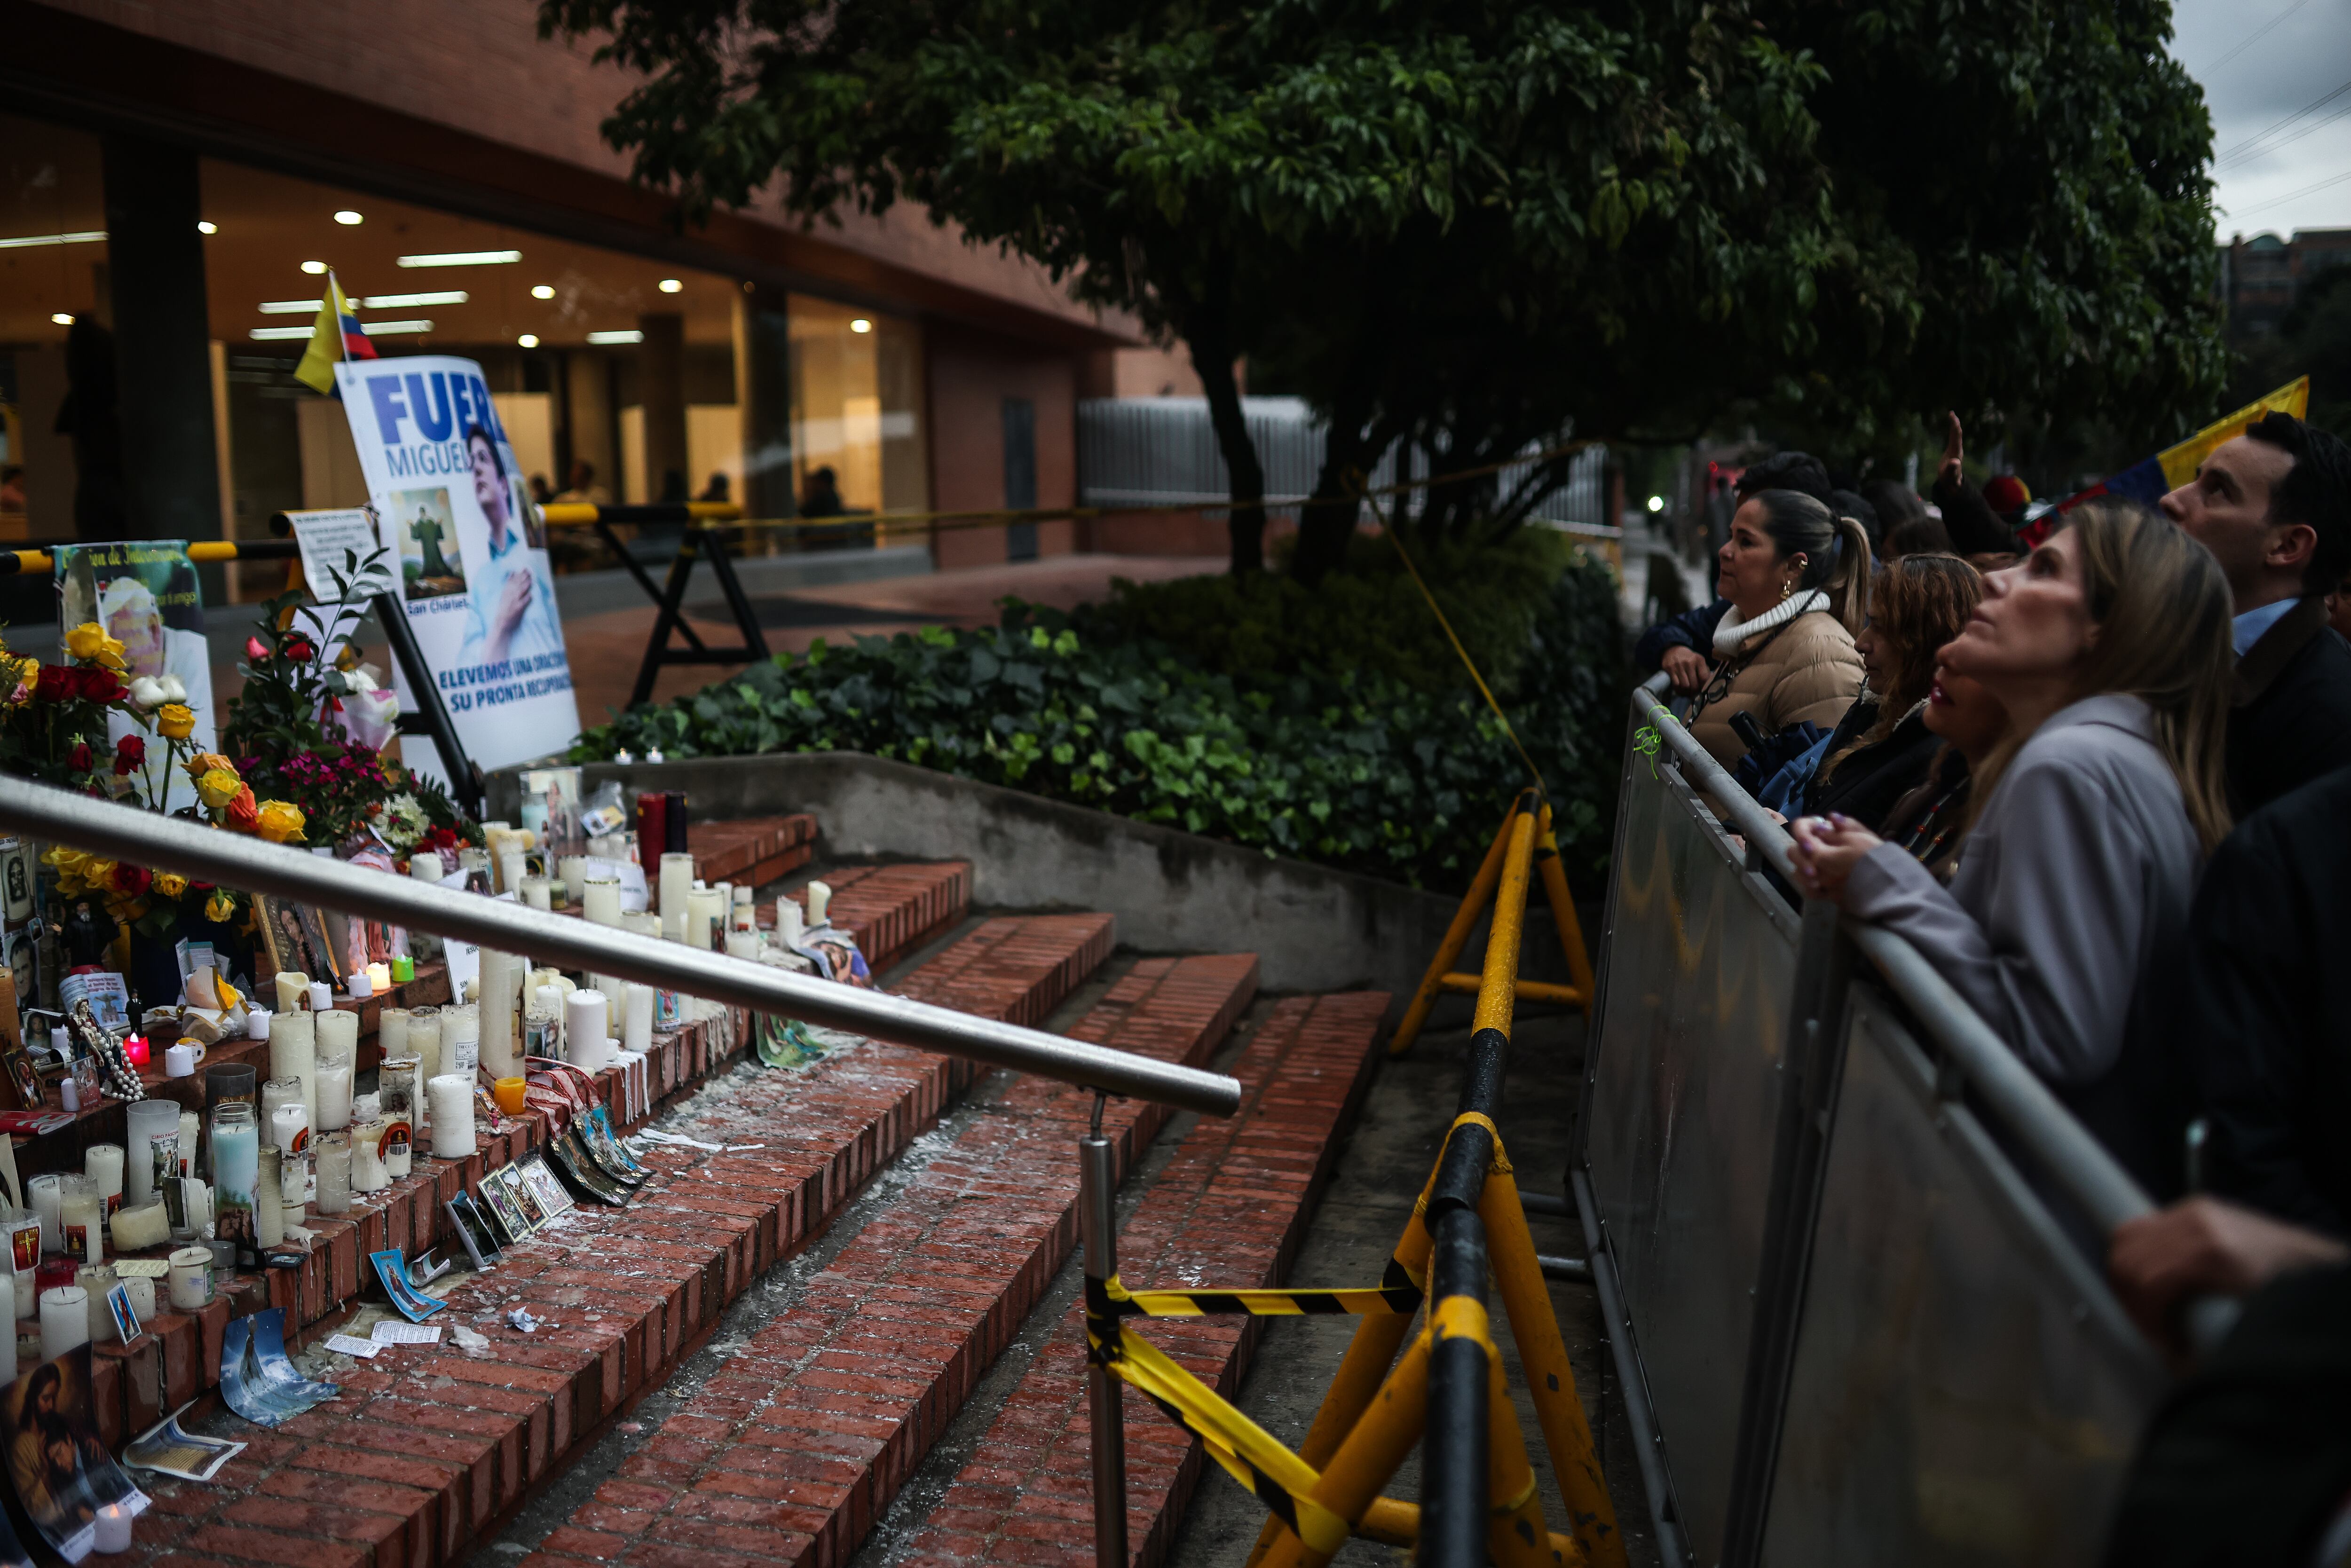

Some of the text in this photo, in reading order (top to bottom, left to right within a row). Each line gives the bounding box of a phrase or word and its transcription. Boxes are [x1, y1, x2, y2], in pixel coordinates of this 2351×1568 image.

[366, 370, 508, 444] FUER
[386, 443, 473, 478] MIGUEL
[407, 602, 426, 615] San
[439, 660, 513, 689] ELEVEMOS
[513, 657, 533, 678] UNA
[450, 692, 472, 713] SU
[476, 683, 526, 707] PRONTA
